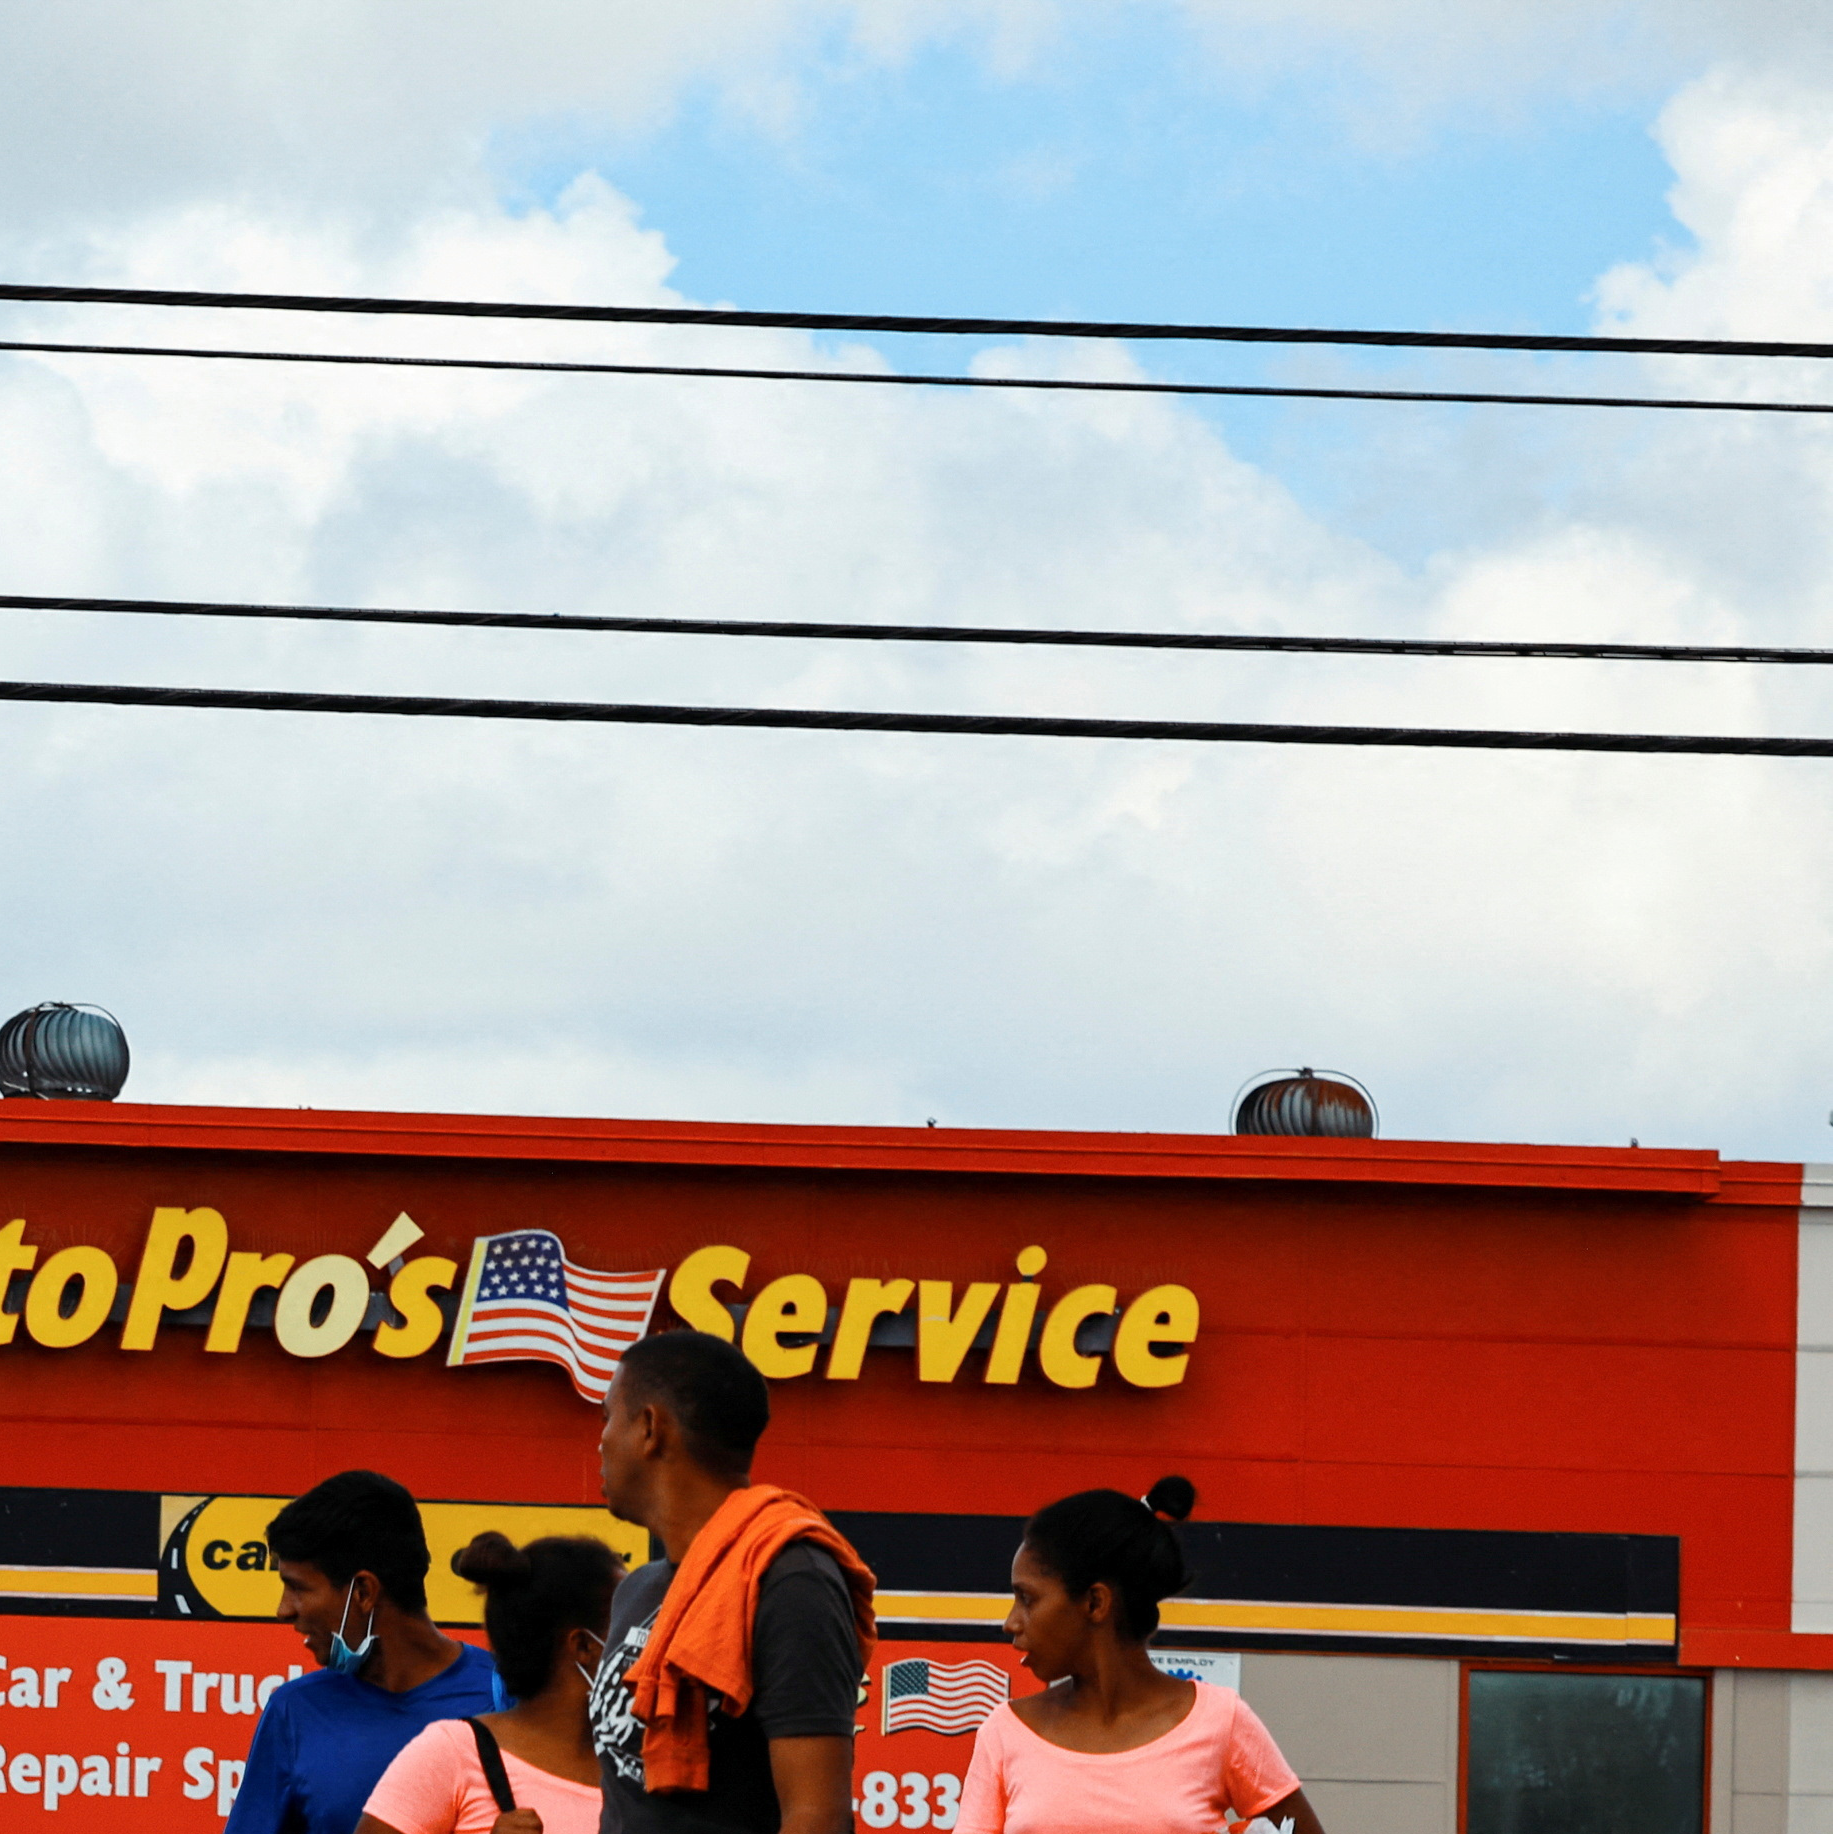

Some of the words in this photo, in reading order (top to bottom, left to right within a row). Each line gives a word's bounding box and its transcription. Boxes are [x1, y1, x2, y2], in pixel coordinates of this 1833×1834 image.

[669, 1245, 1199, 1388] Service
[92, 1657, 135, 1711] &
[155, 1659, 304, 1715] Truc
[1167, 1657, 1215, 1667] EMPLOY
